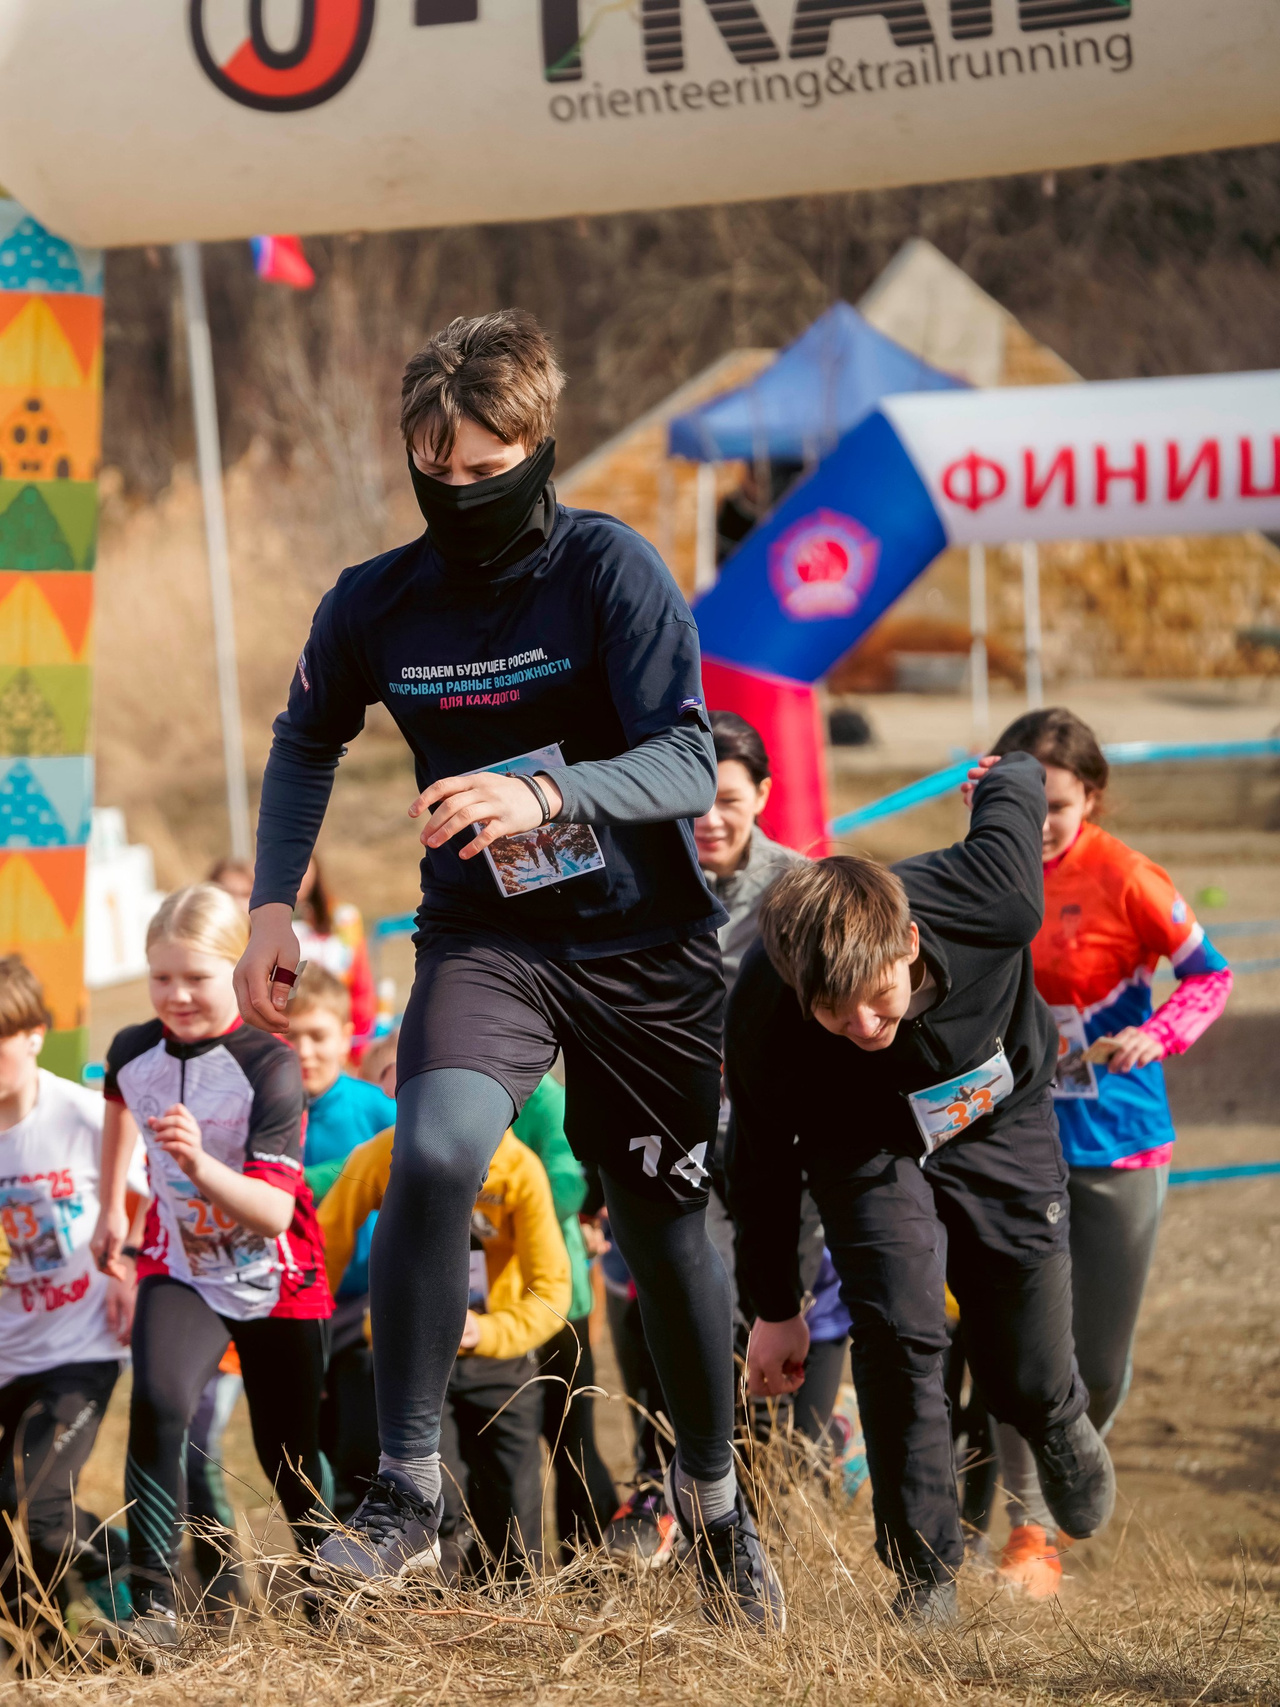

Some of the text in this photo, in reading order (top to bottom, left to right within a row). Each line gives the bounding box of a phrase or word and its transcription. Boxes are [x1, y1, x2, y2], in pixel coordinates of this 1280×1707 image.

[549, 29, 1134, 122] orienteering&trailrunning
[388, 657, 572, 696] ОТКРЫВАЯ РАВНЫЕ ВОЗМОЖНОСТИ
[401, 647, 549, 680] СОЗДАЕМ БУДУЩЕЕ РОССИИ,
[439, 688, 521, 710] ДЛЯ КАЖДОГО!
[946, 1087, 994, 1136] 33
[1, 1204, 38, 1240] 43
